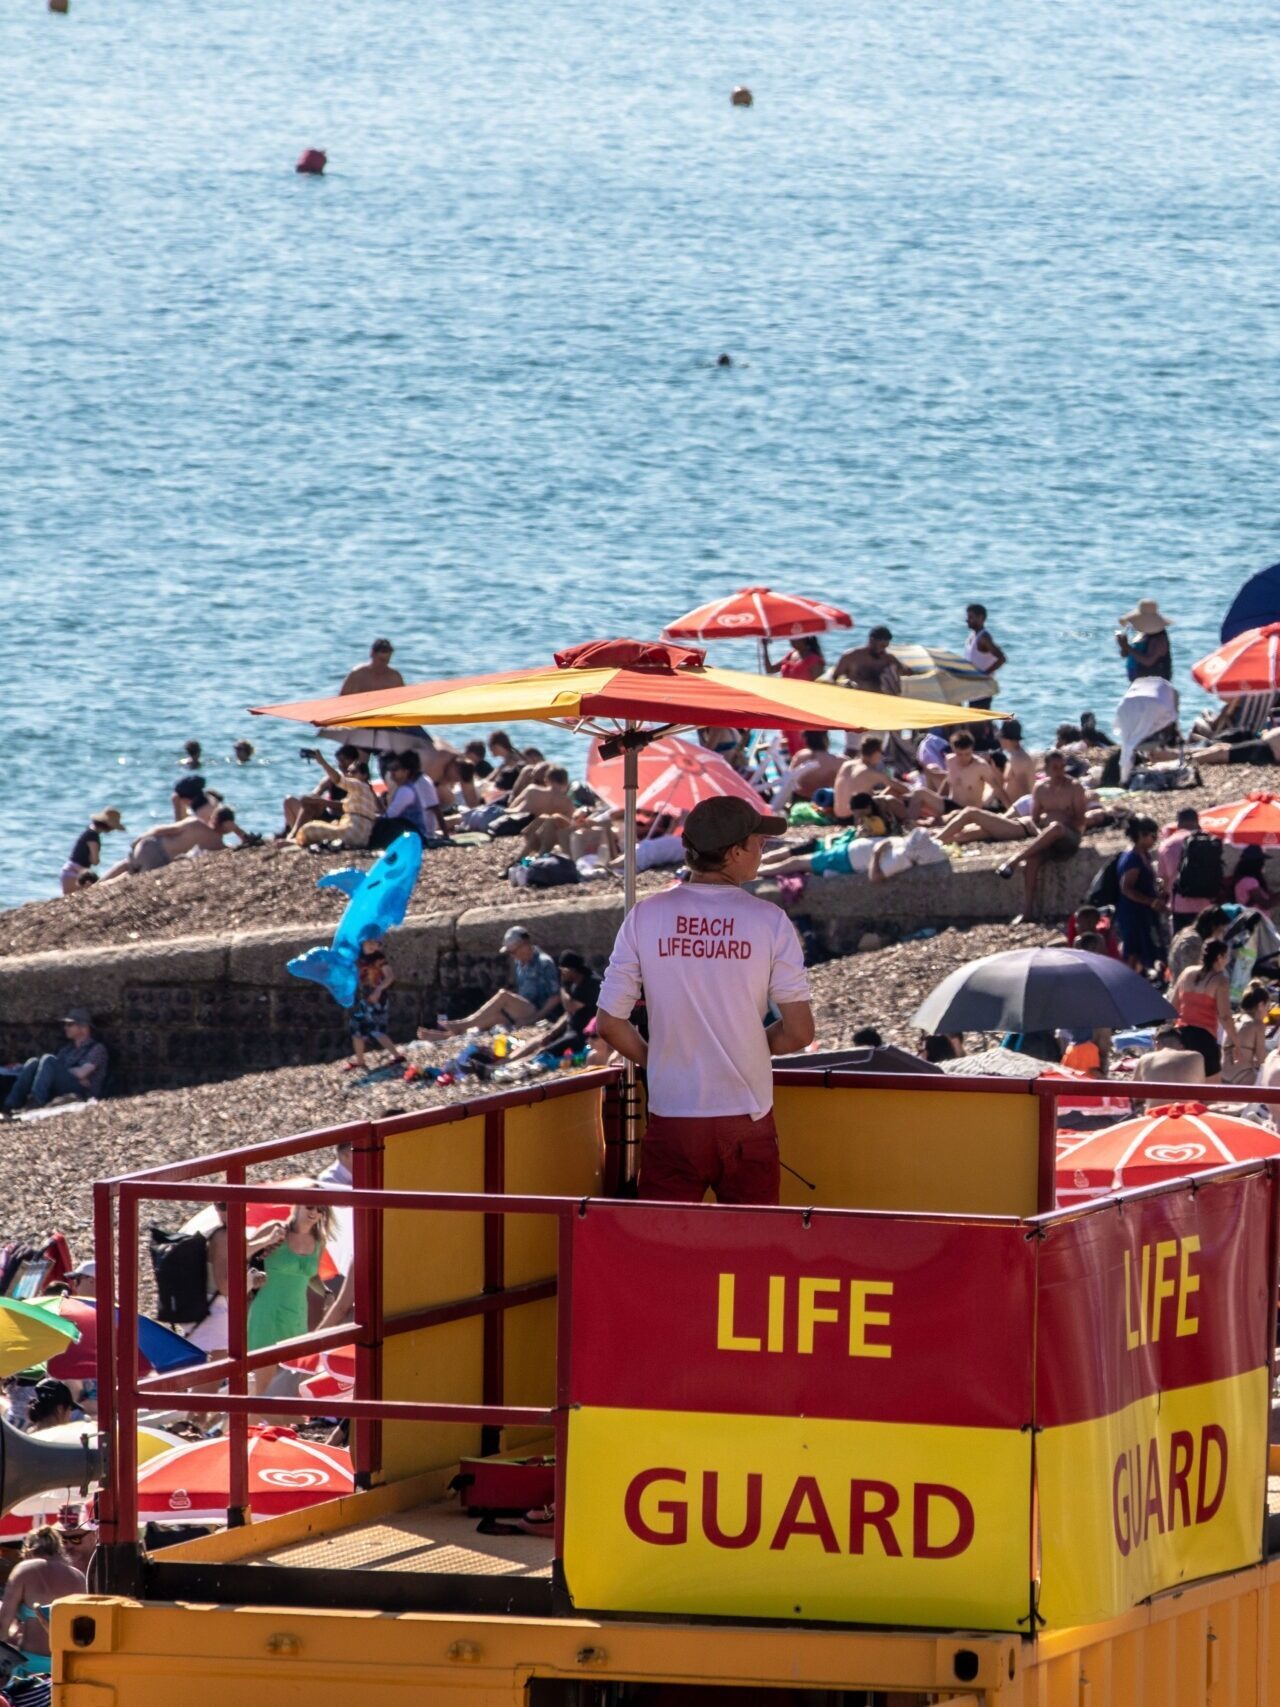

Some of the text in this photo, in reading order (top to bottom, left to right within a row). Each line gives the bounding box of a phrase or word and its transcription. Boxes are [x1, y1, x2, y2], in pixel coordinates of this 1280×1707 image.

[658, 937, 752, 960] LIFEGUARD
[676, 915, 734, 936] BEACH
[716, 1273, 893, 1358] LIFE
[1124, 1235, 1201, 1351] LIFE
[624, 1467, 975, 1560] GUARD
[1112, 1424, 1229, 1558] GUARD
